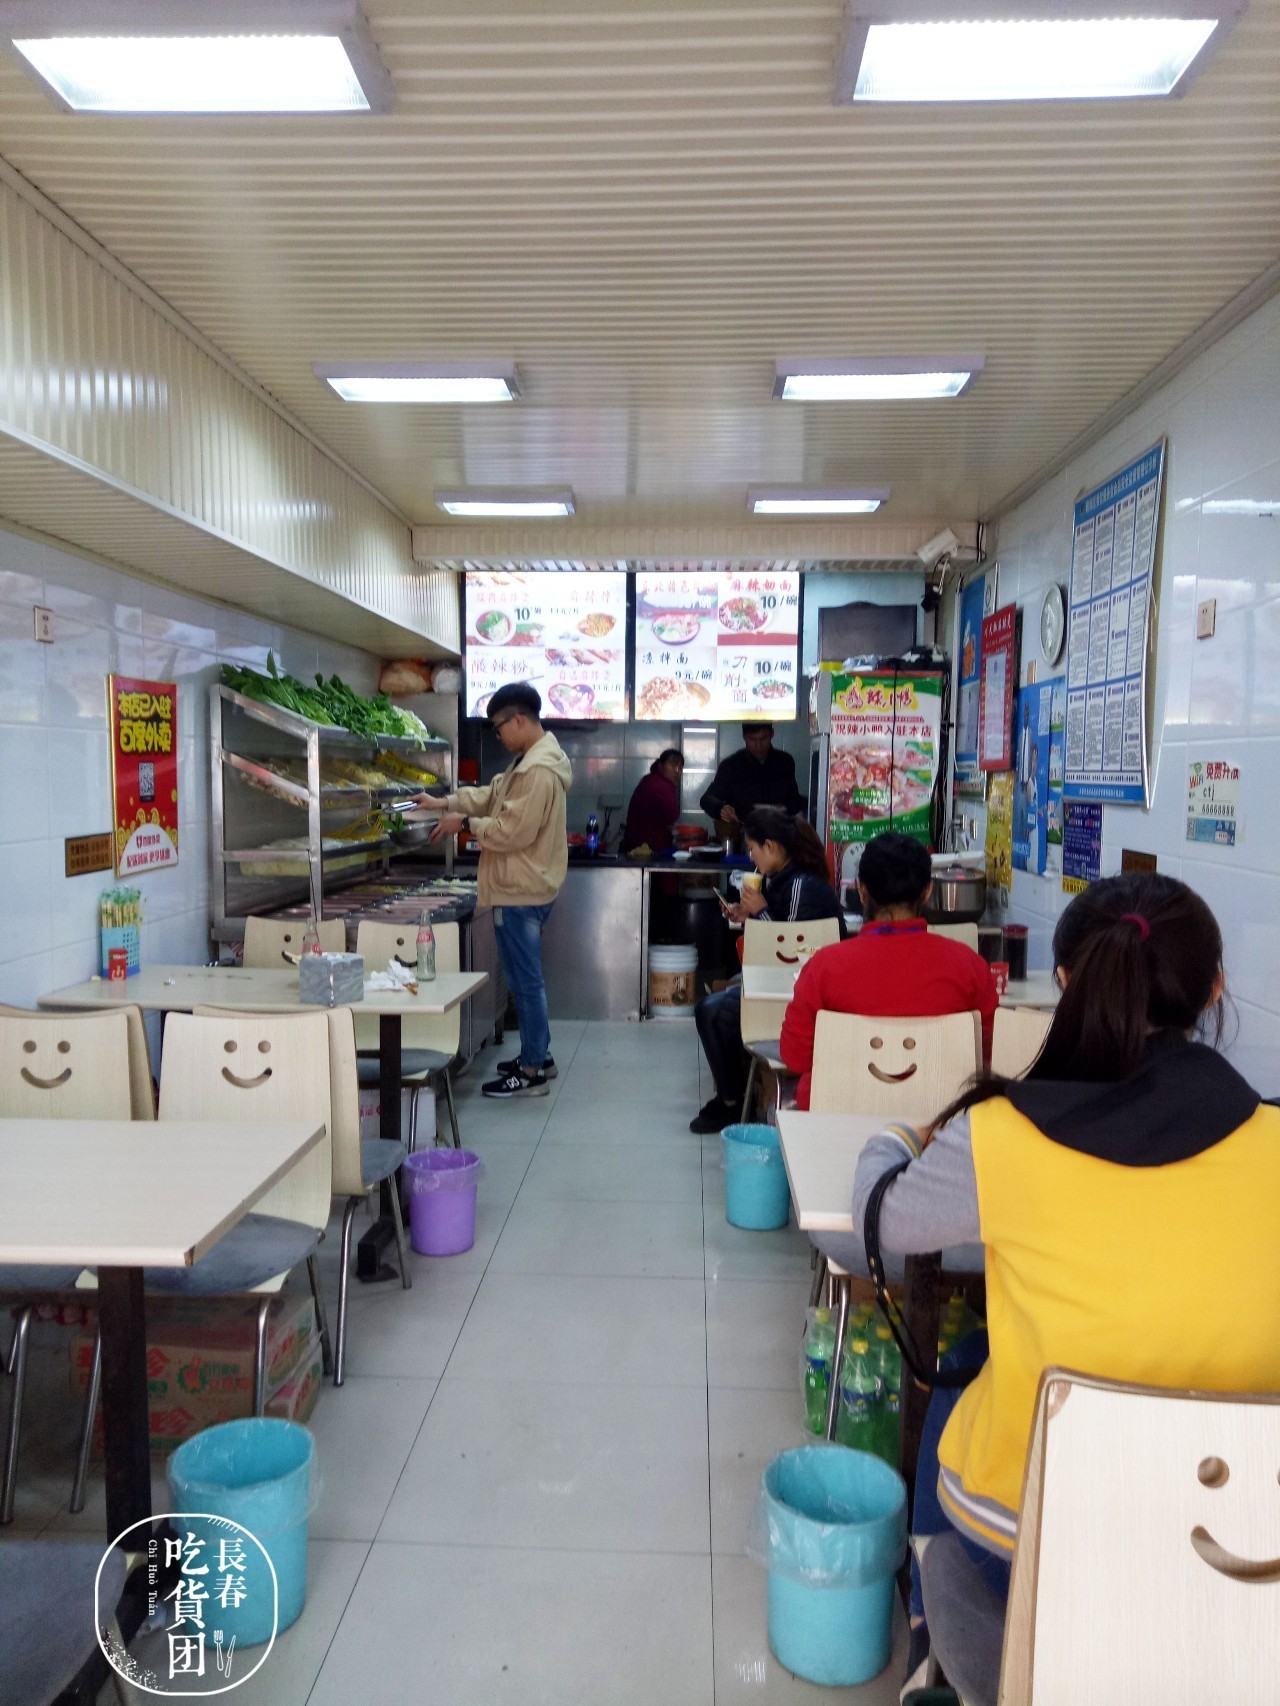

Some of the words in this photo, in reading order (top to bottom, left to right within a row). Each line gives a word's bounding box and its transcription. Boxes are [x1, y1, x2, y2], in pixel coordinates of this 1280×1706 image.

[118, 691, 171, 719] 本店已入驻
[119, 719, 172, 753] 百度外卖
